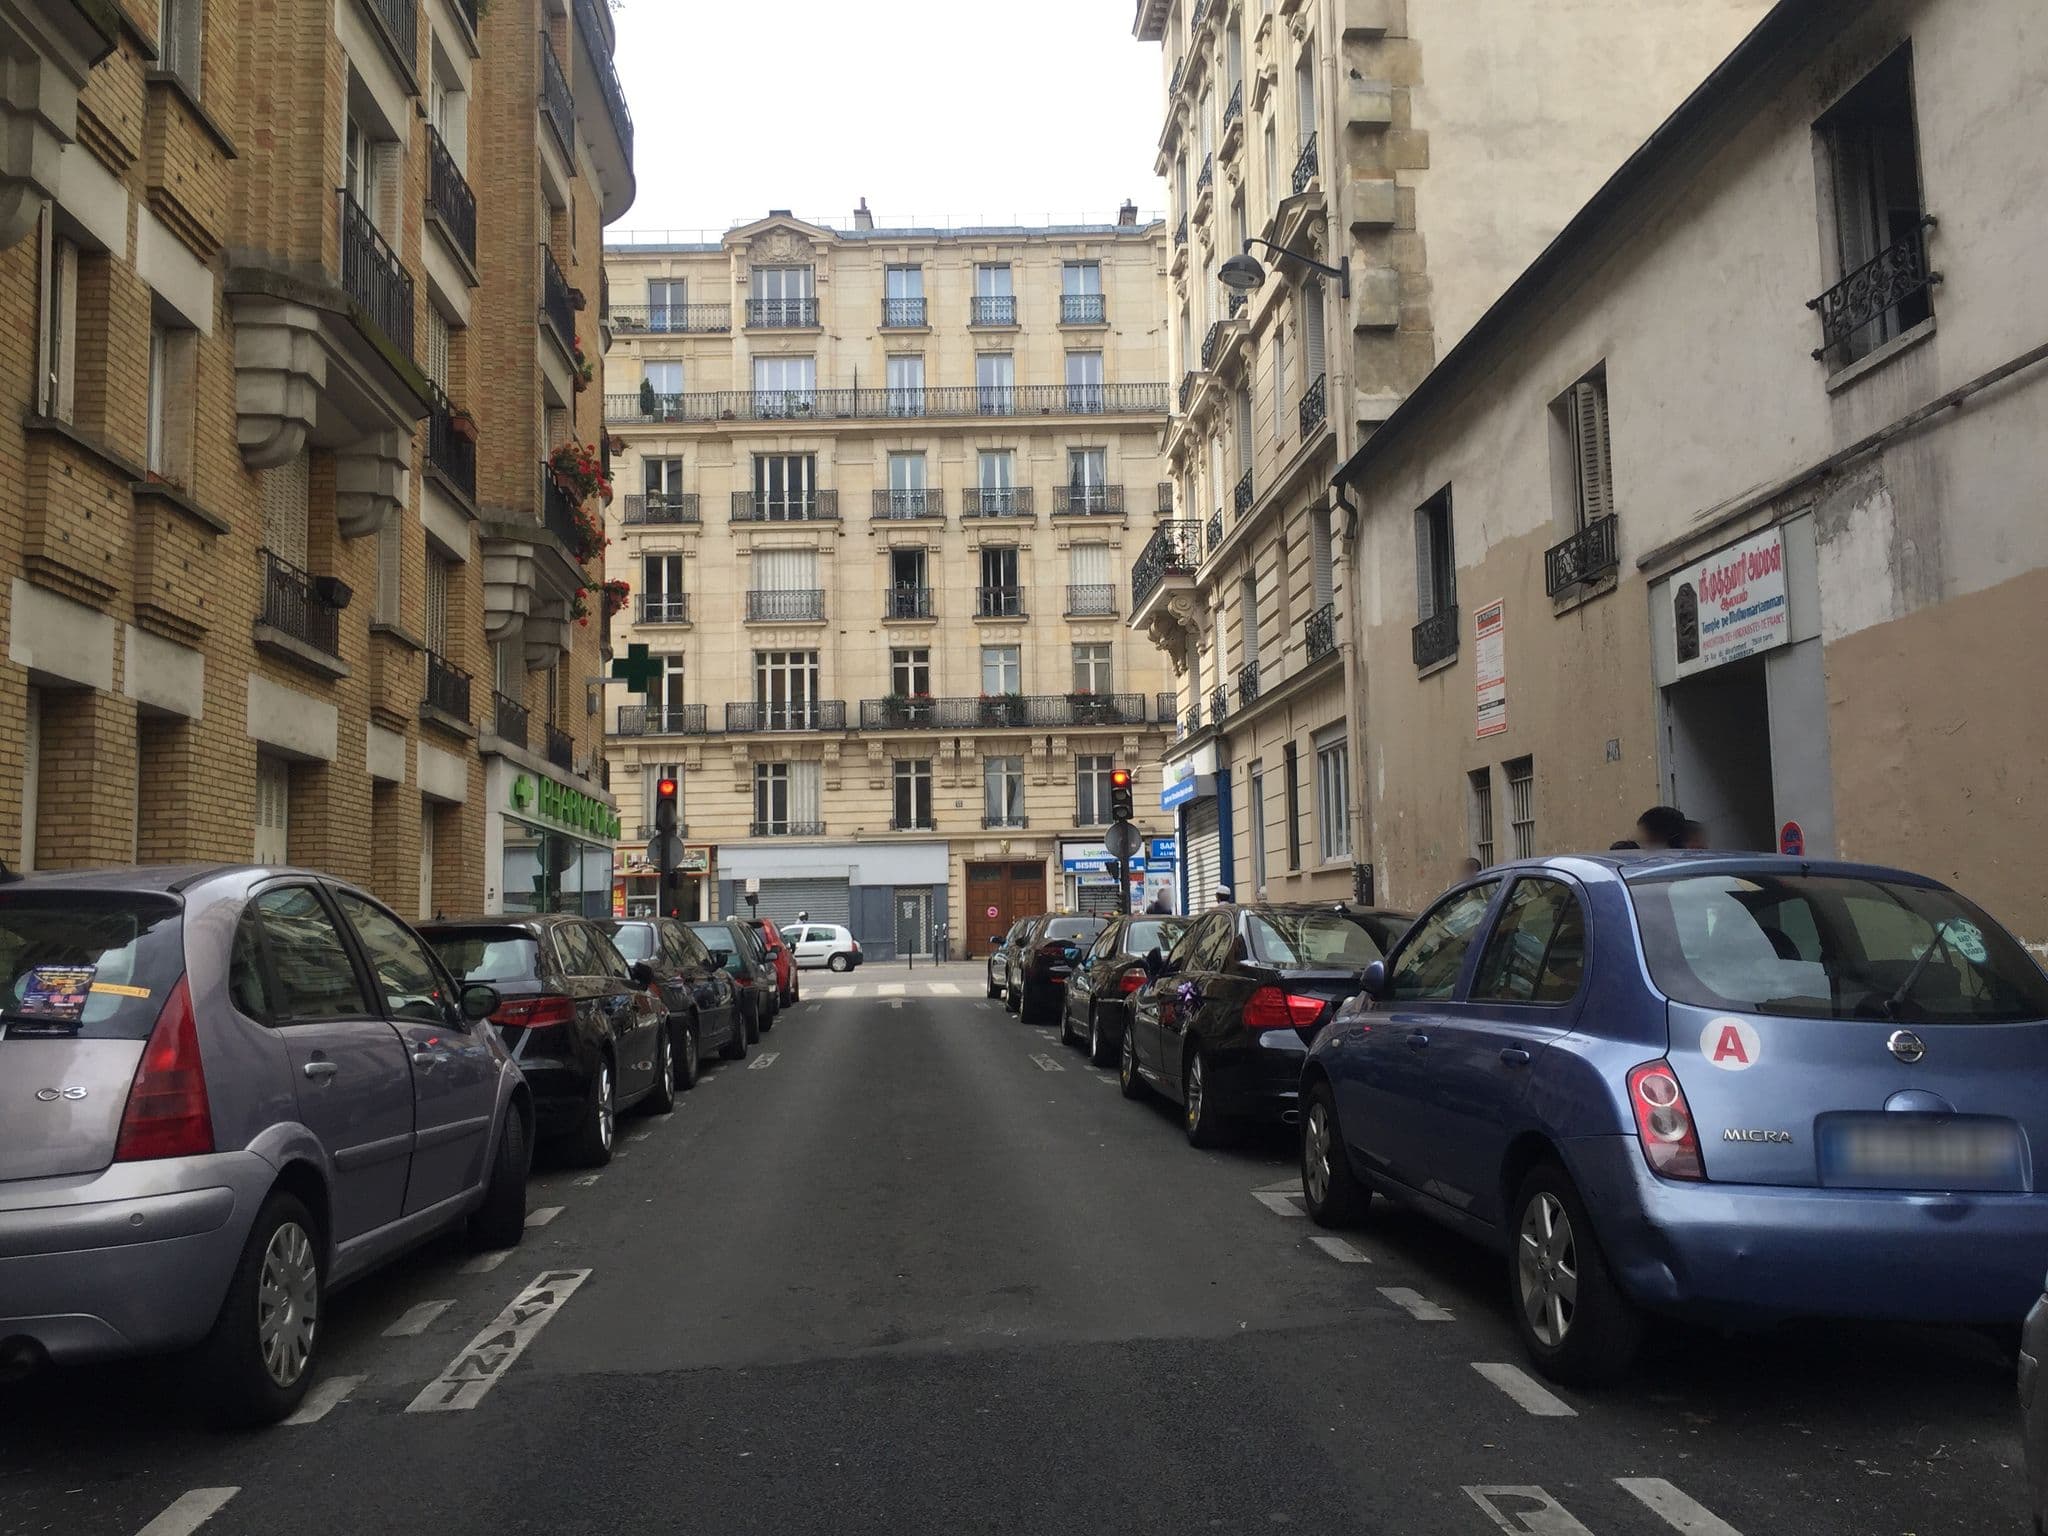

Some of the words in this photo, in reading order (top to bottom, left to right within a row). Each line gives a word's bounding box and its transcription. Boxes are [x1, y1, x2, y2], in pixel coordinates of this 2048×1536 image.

[1713, 1025, 1749, 1063] A
[36, 1087, 88, 1101] C3
[1723, 1128, 1793, 1143] MICRA
[440, 1272, 581, 1404] PAYANT
